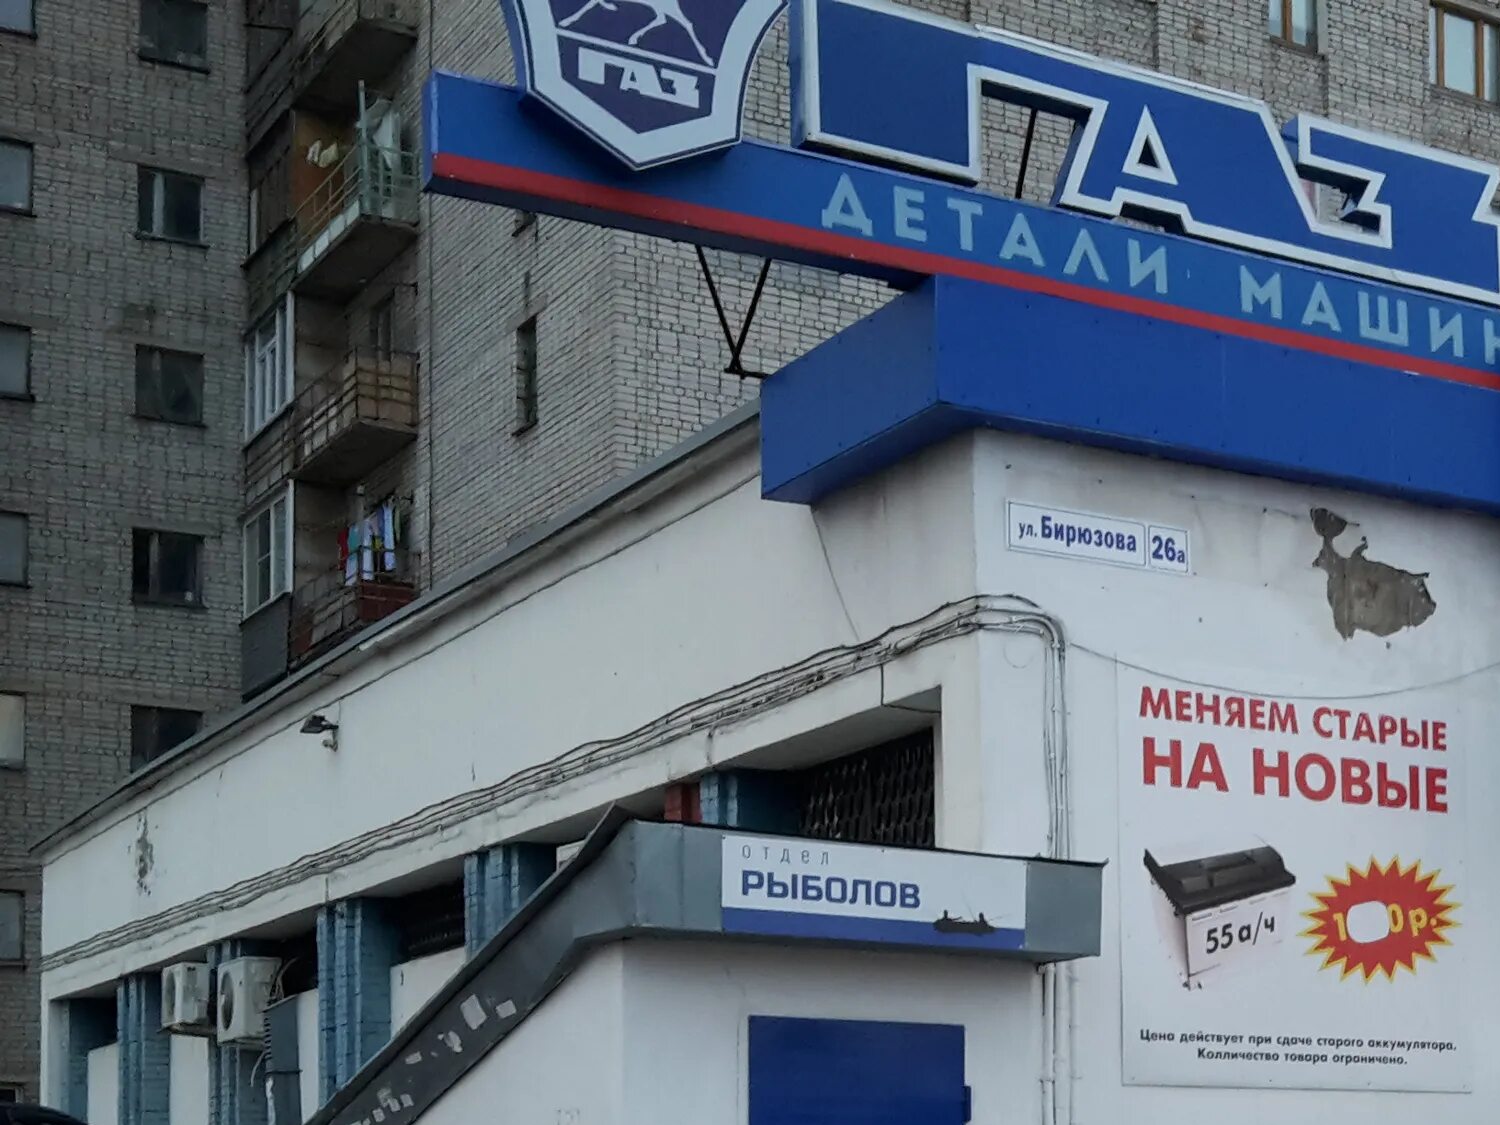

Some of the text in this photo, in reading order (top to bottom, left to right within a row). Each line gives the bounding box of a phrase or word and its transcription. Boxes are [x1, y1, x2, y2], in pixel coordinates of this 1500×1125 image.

[578, 47, 700, 108] ГАЗ
[822, 173, 1168, 295] ДЕТАЛИ
[1018, 515, 1186, 564] ул. Бирюзова 26а
[1139, 686, 1447, 751] МЕНЯЕМ СТАРЫЕ
[1142, 736, 1448, 814] НА НОВЫЕ
[742, 844, 829, 865] отдел
[742, 870, 921, 909] РЫБОЛОВ
[1140, 1029, 1175, 1042] Цена
[1180, 1031, 1244, 1046] действует
[1248, 1035, 1272, 1047] при
[1276, 1036, 1313, 1047] сдаче
[1317, 1037, 1364, 1049] старого
[1197, 1048, 1408, 1066] Колличество товара ограничено.
